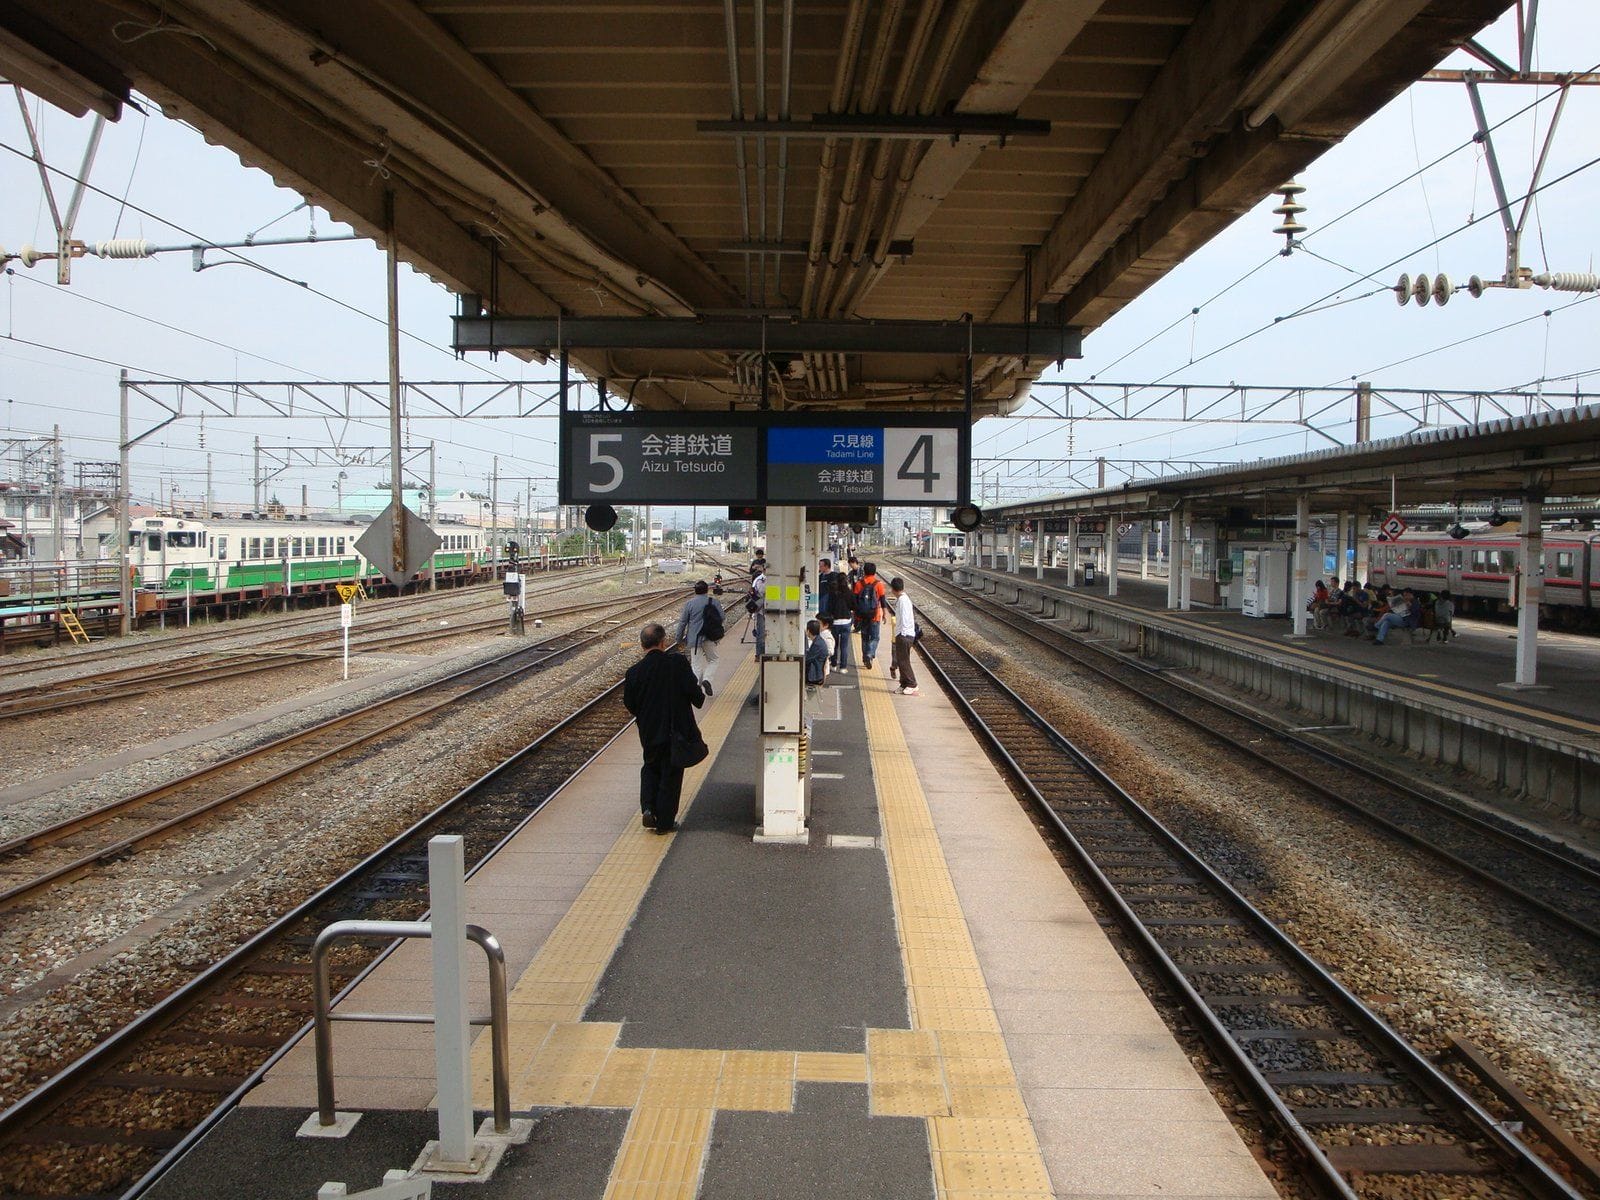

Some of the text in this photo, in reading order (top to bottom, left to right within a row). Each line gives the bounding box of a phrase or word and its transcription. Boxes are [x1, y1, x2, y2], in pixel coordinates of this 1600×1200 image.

[641, 434, 733, 456] 会津鉄道
[832, 434, 874, 448] 只見線
[826, 450, 874, 458] Tadami Line
[589, 434, 624, 493] 5
[641, 460, 725, 473] Aizu Tetsudō
[897, 435, 941, 493] 4
[818, 469, 874, 483] 会津鉄道
[822, 485, 840, 493] Aizu
[1390, 521, 1399, 533] 2
